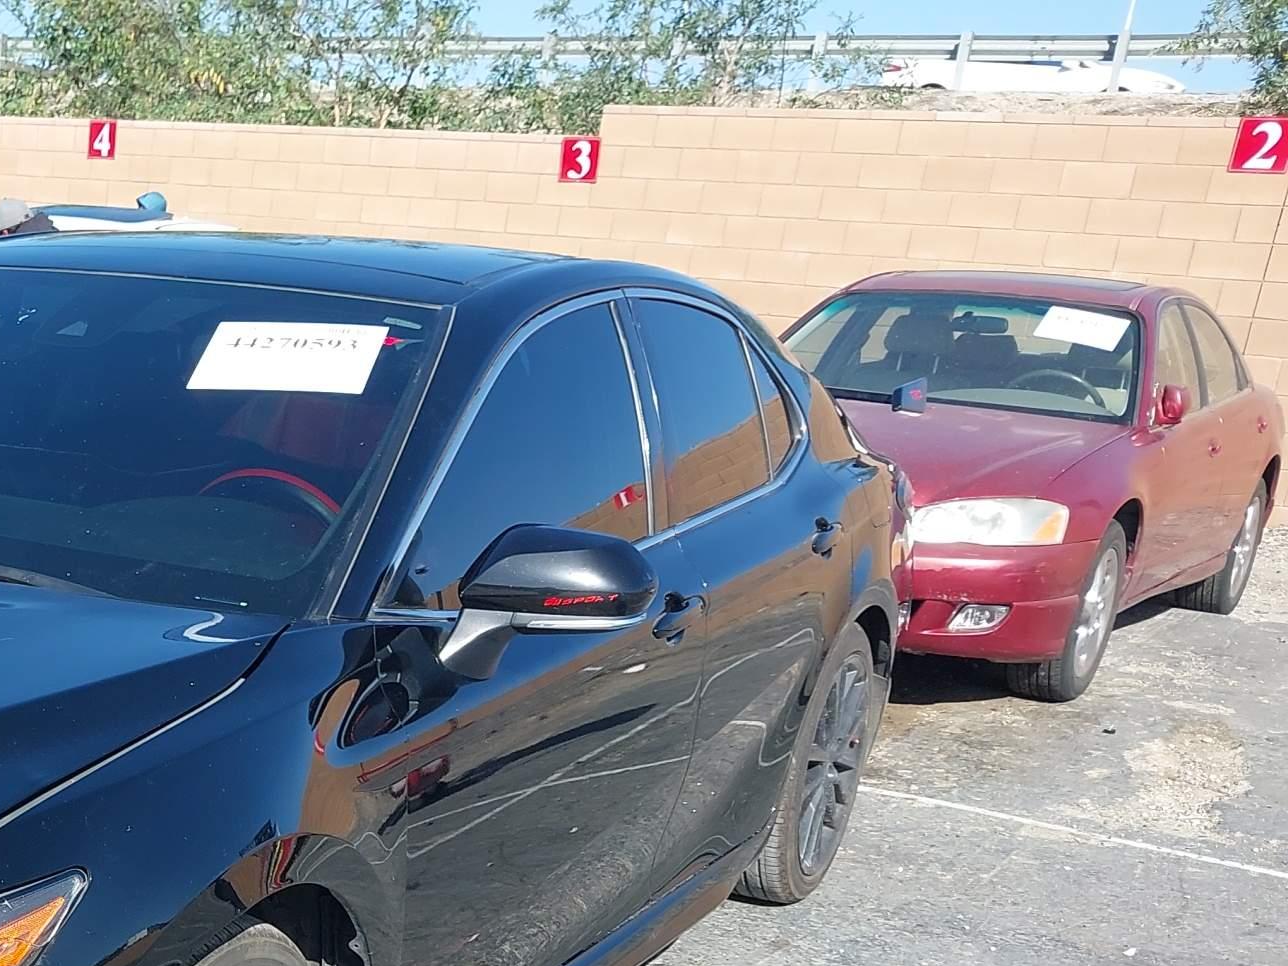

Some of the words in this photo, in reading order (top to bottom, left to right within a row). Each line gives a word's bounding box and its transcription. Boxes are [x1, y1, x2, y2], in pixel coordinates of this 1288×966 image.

[92, 121, 111, 157] 4
[1241, 121, 1283, 170] 2
[566, 139, 592, 180] 3
[225, 336, 358, 351] 44270593
